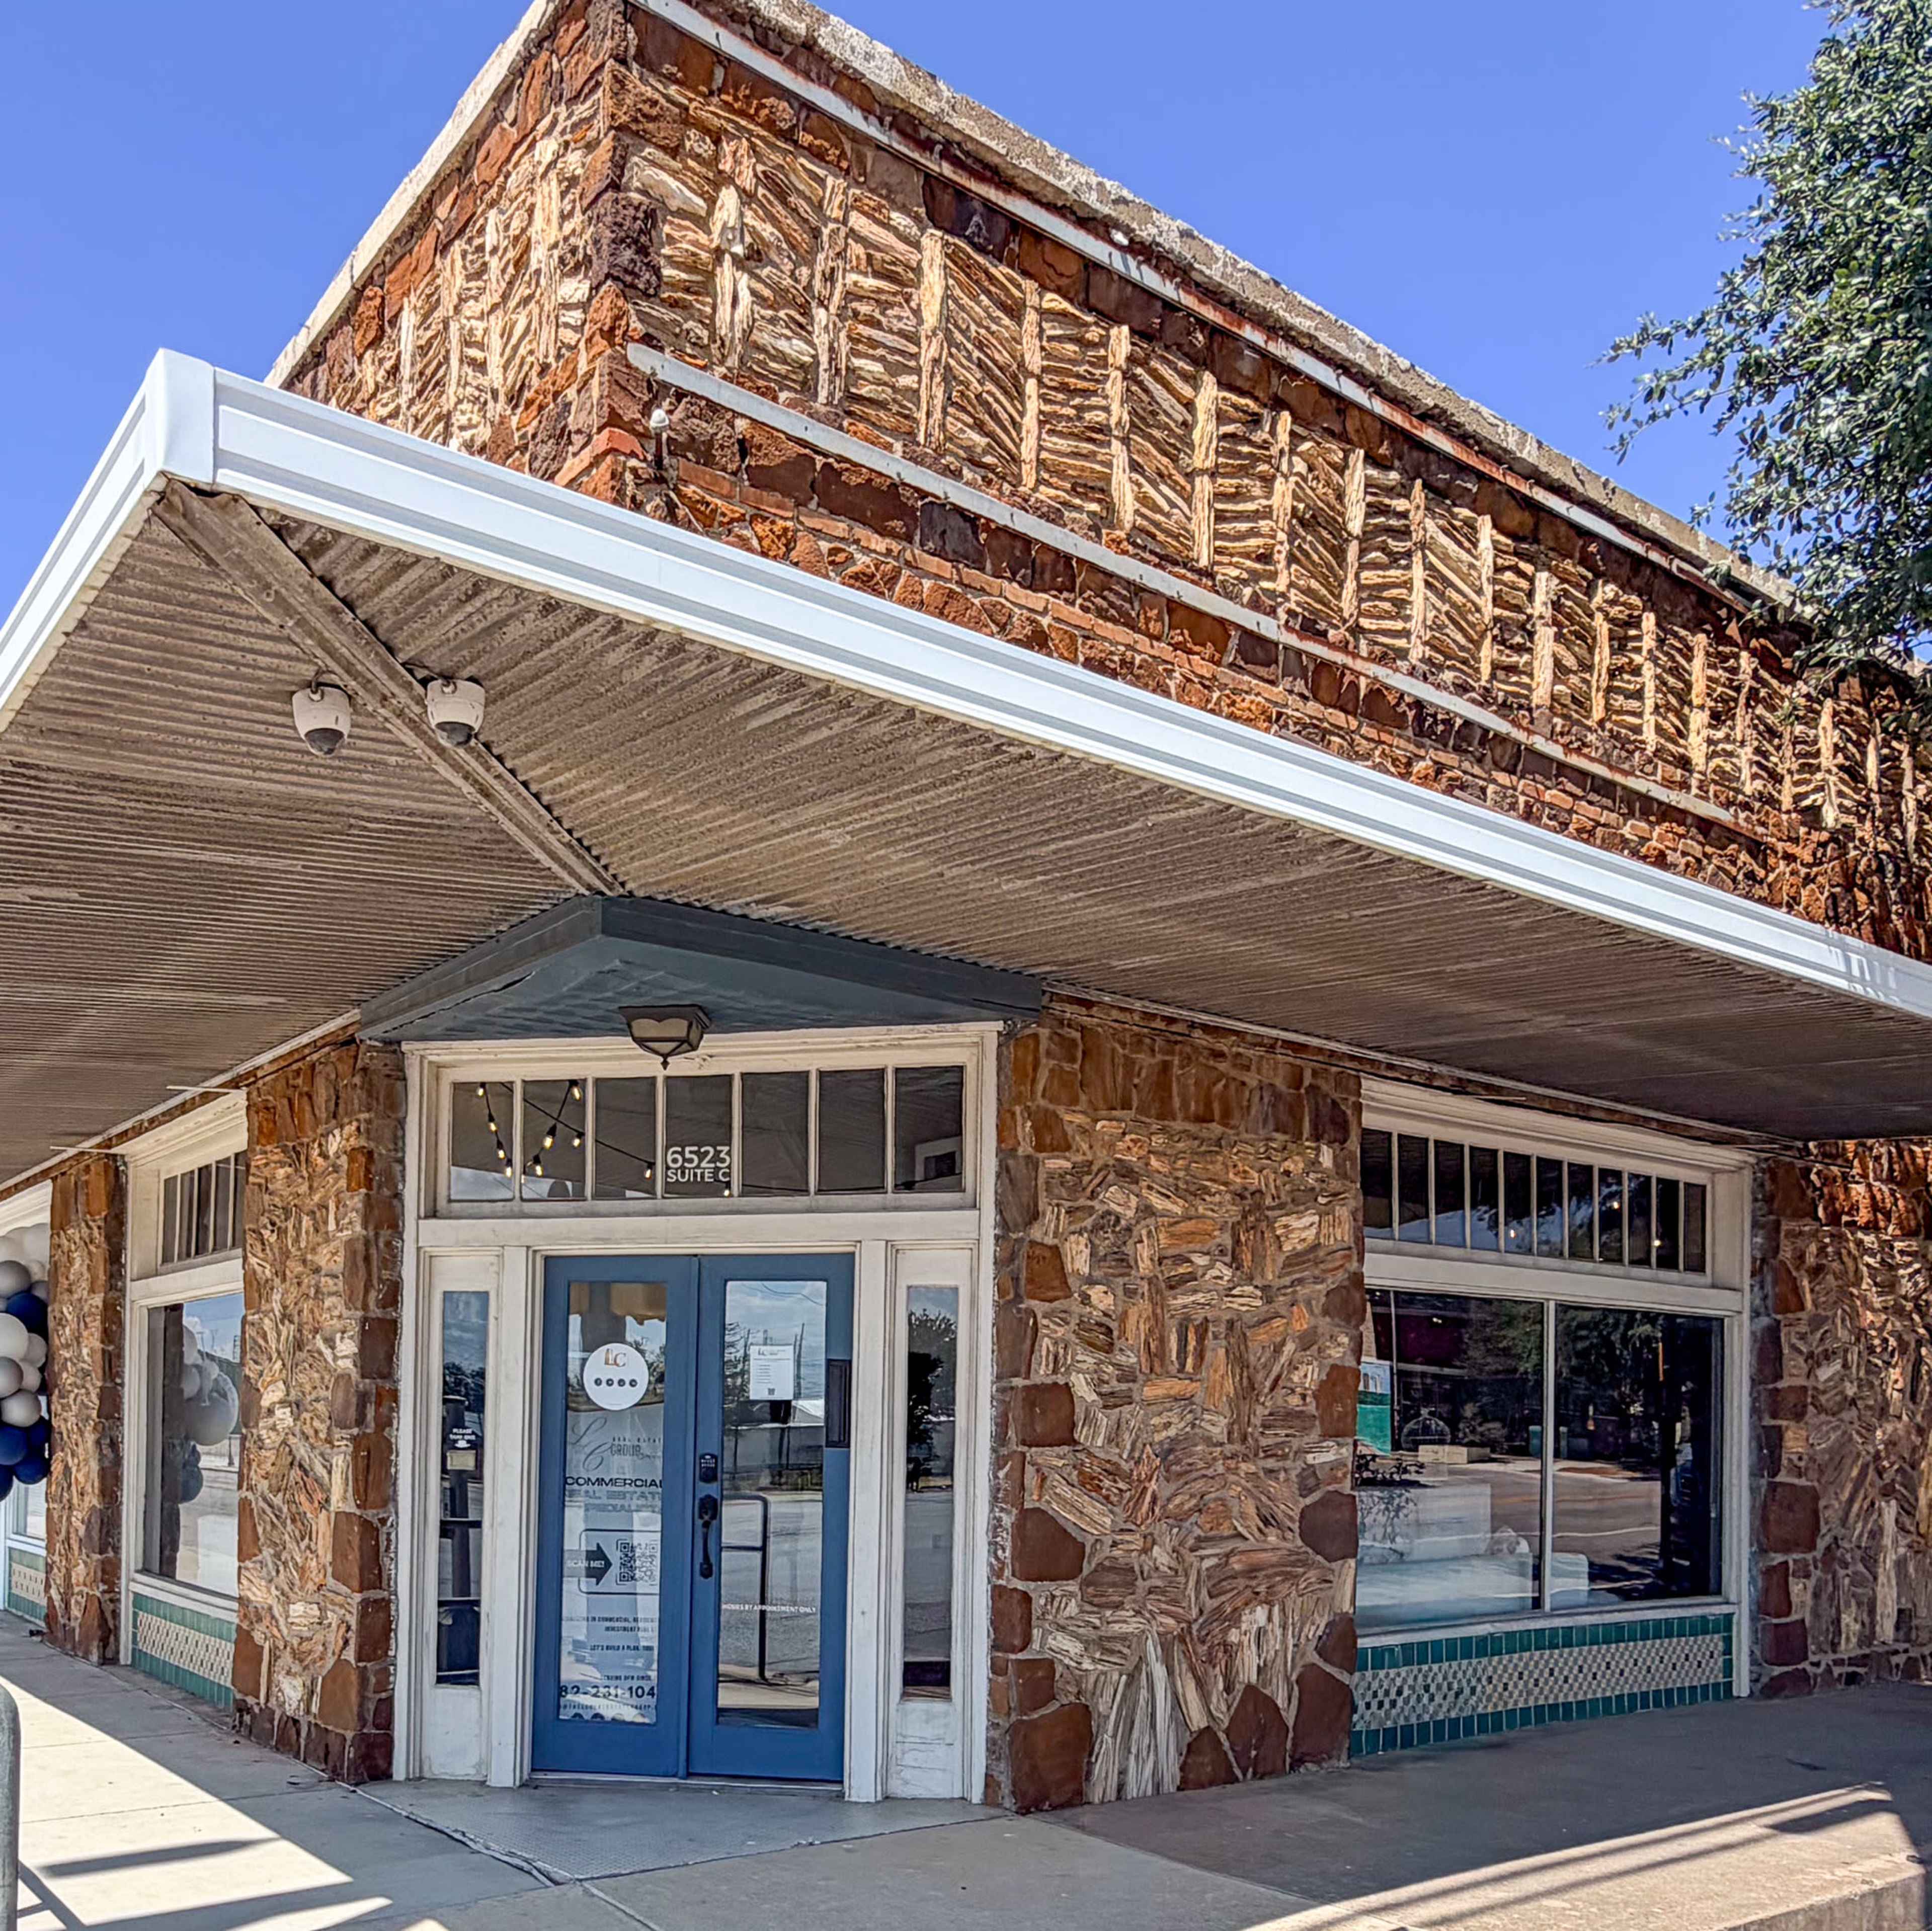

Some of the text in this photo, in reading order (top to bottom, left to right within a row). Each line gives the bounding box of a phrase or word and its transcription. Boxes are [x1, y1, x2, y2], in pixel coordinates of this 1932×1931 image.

[667, 1146, 731, 1168] 6523
[667, 1168, 730, 1182] SUITE C
